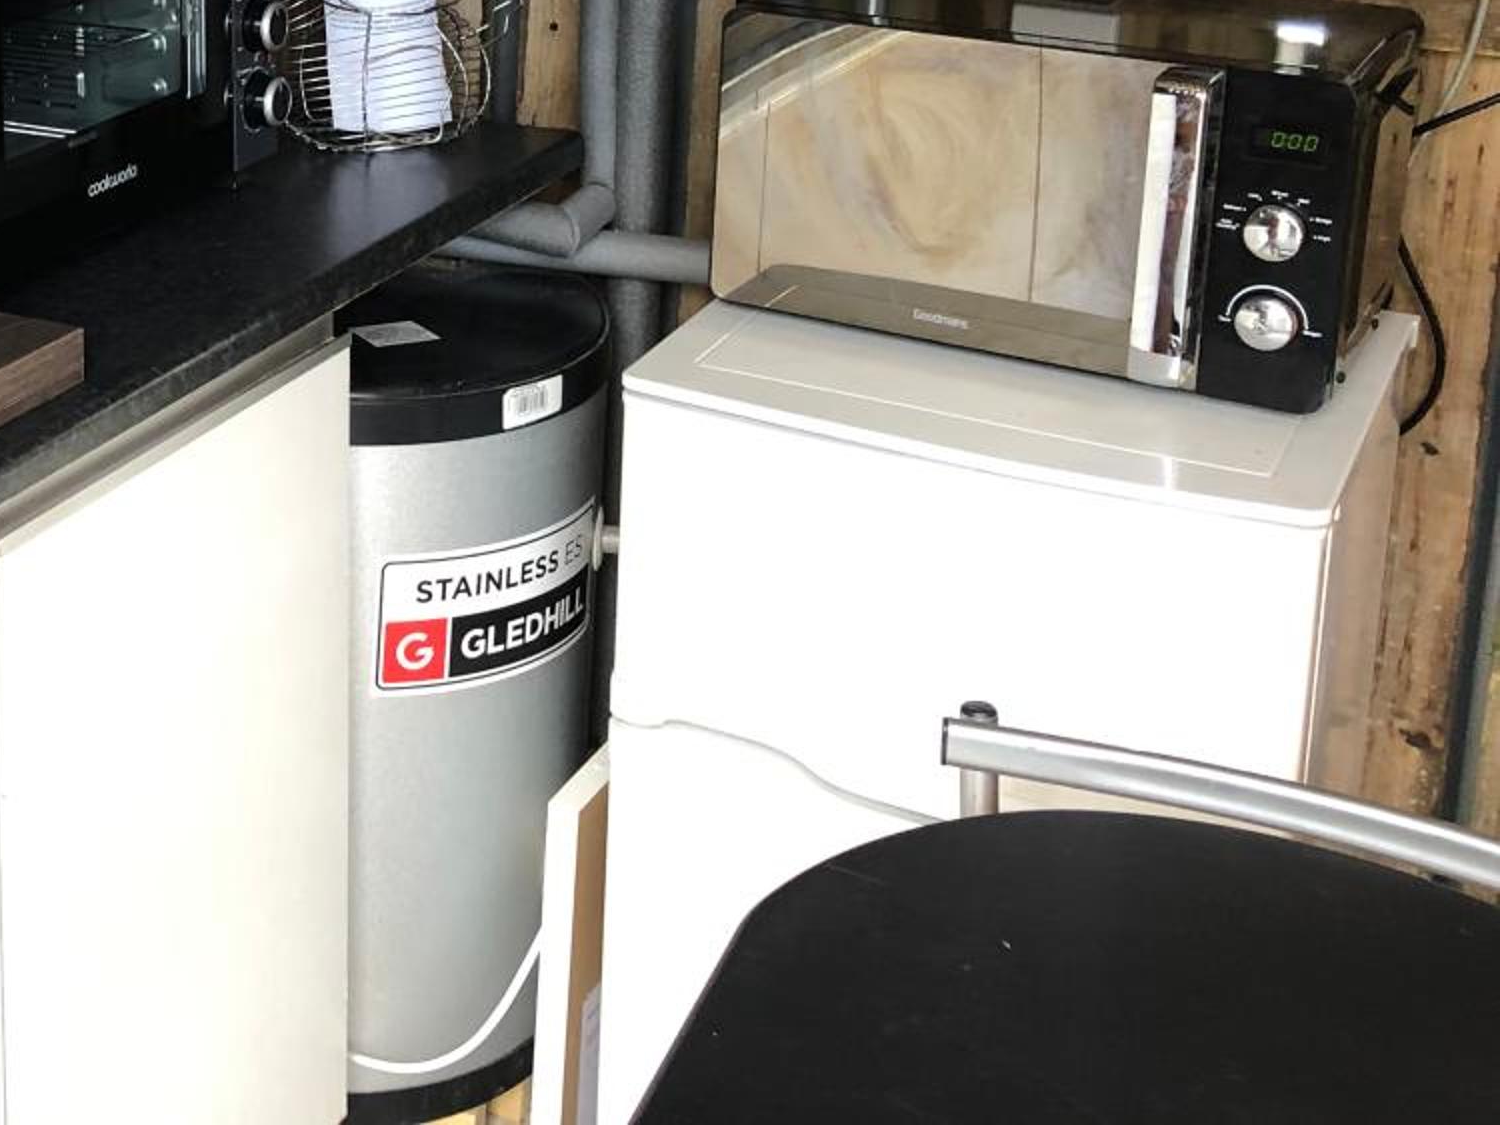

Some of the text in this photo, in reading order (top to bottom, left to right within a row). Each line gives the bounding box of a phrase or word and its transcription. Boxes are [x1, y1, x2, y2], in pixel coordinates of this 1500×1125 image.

[415, 550, 559, 603] STAINLESS
[395, 586, 583, 670] G GLEDHILL
